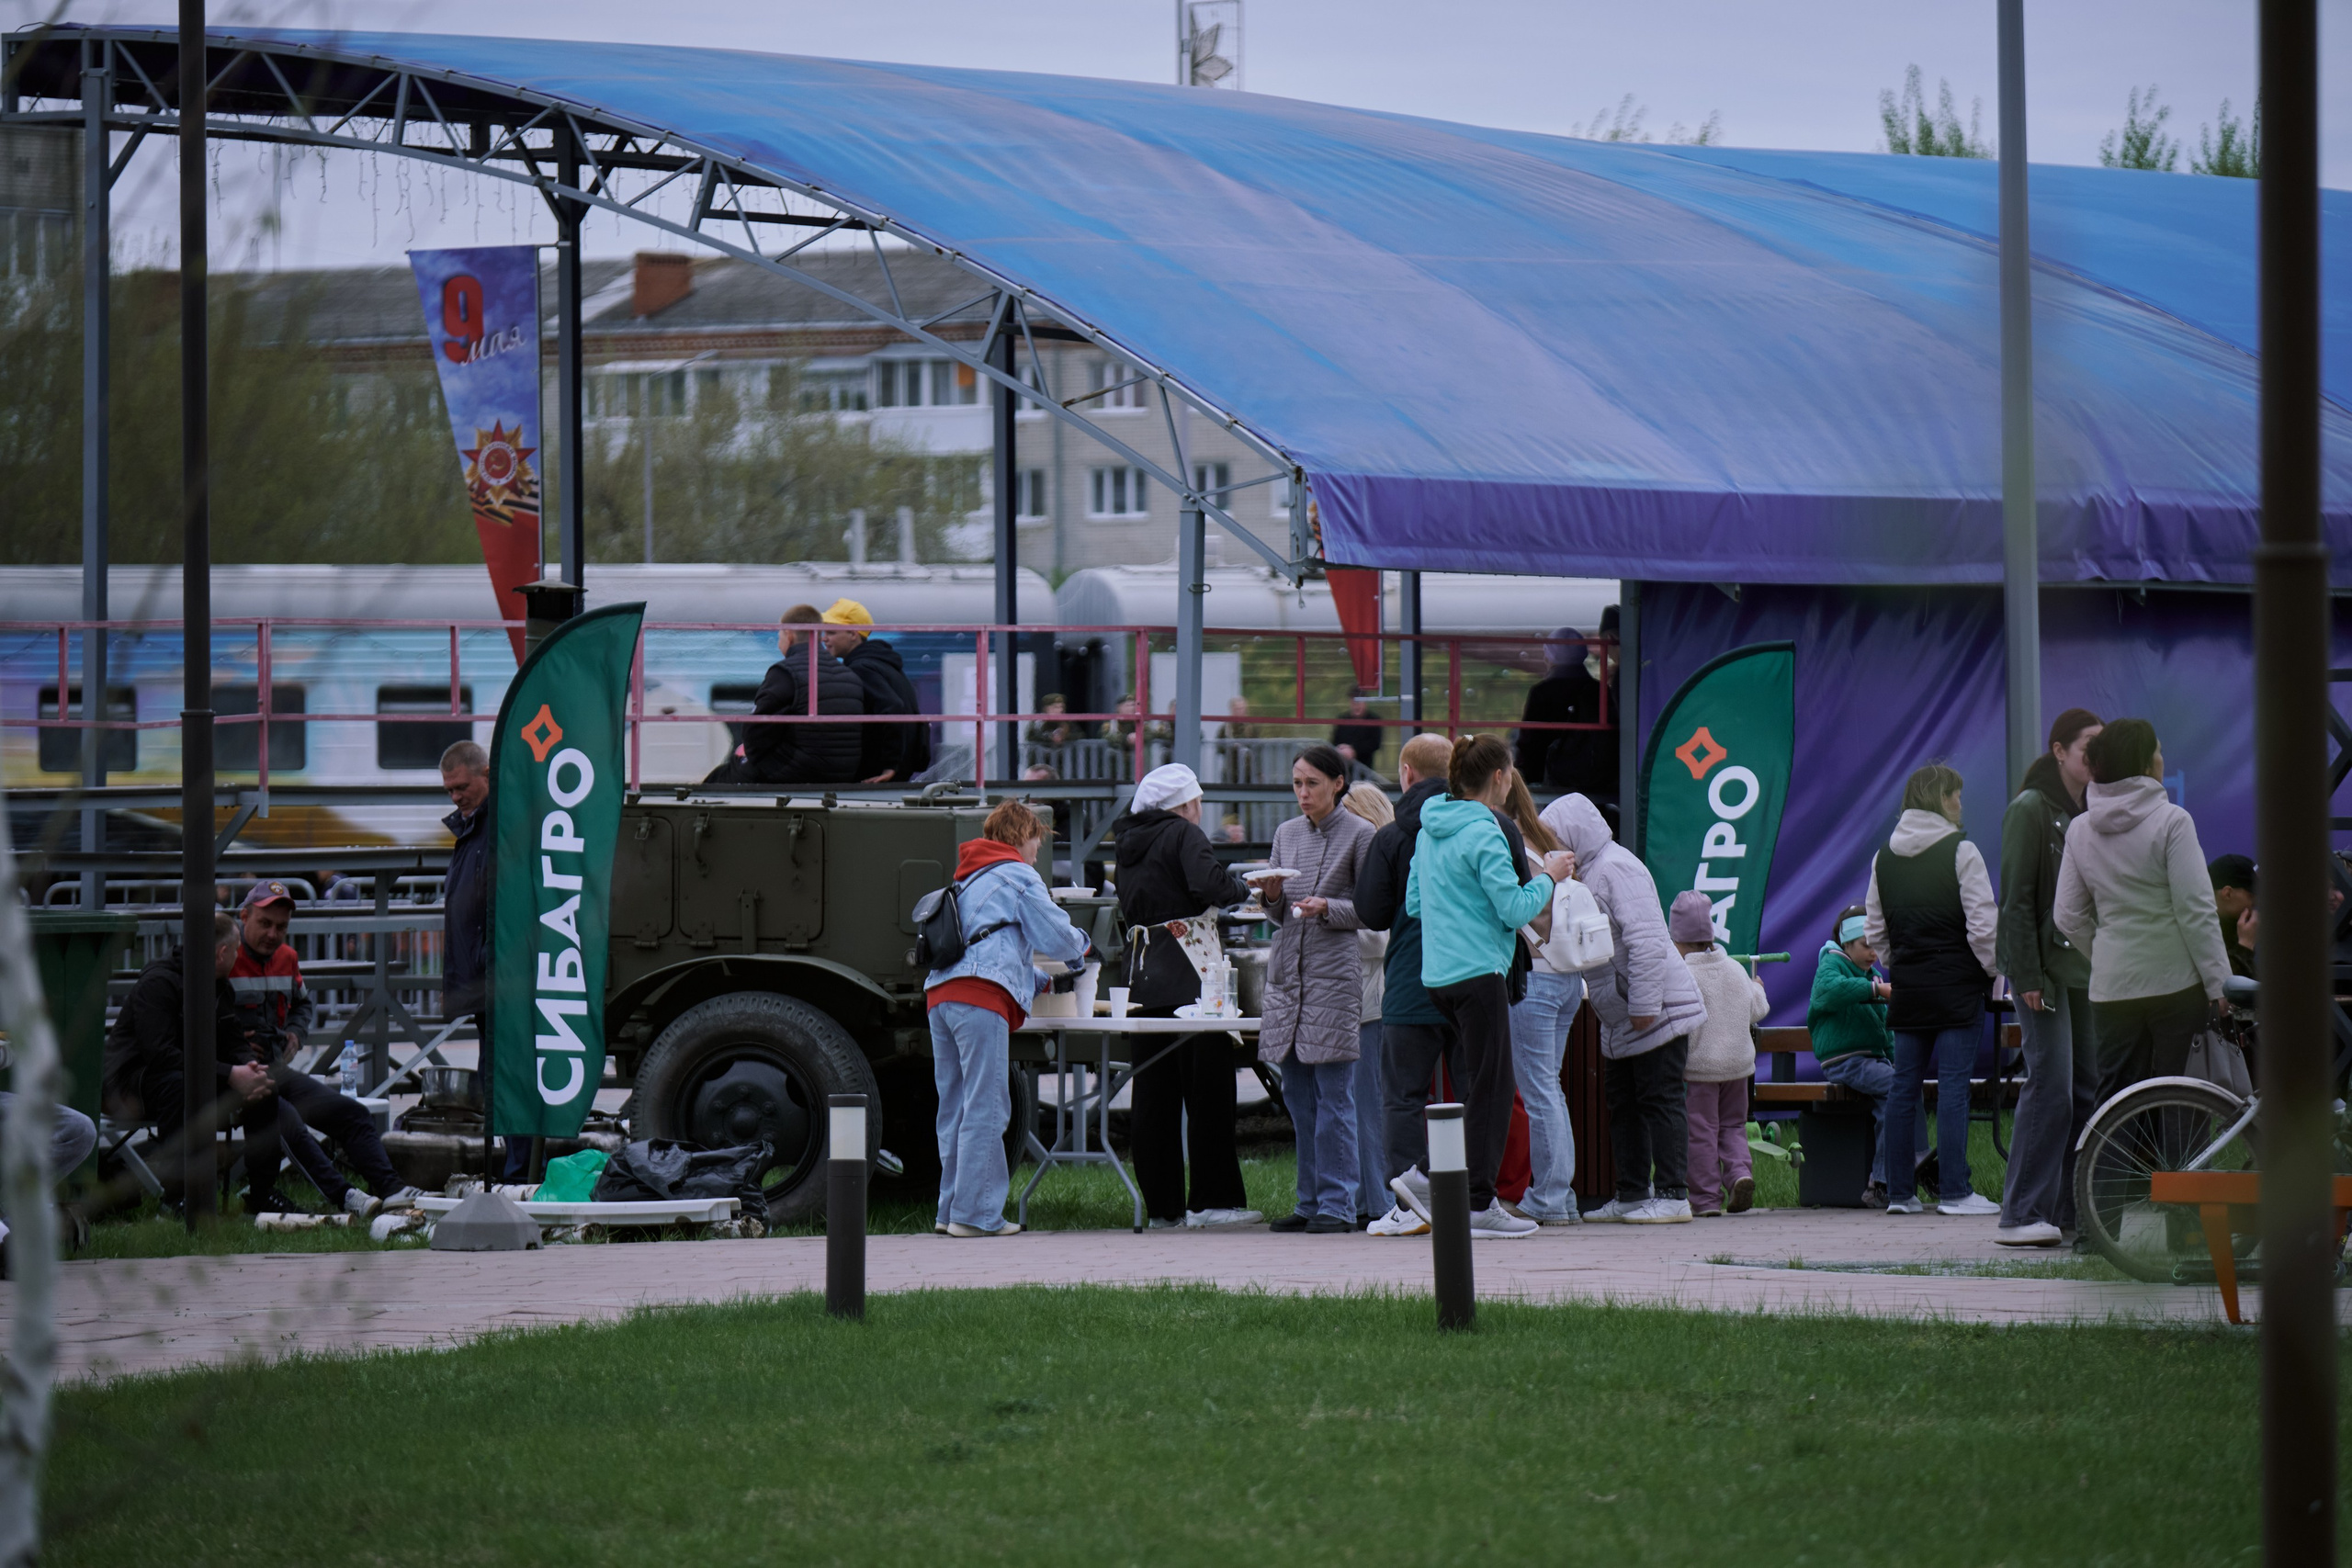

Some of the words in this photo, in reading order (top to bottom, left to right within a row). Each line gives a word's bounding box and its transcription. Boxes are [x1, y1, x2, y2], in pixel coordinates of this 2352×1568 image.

[444, 276, 484, 365] 9
[460, 325, 528, 367] мая
[1690, 764, 1760, 944] АГРО
[535, 747, 595, 1107] СИБАГРО
